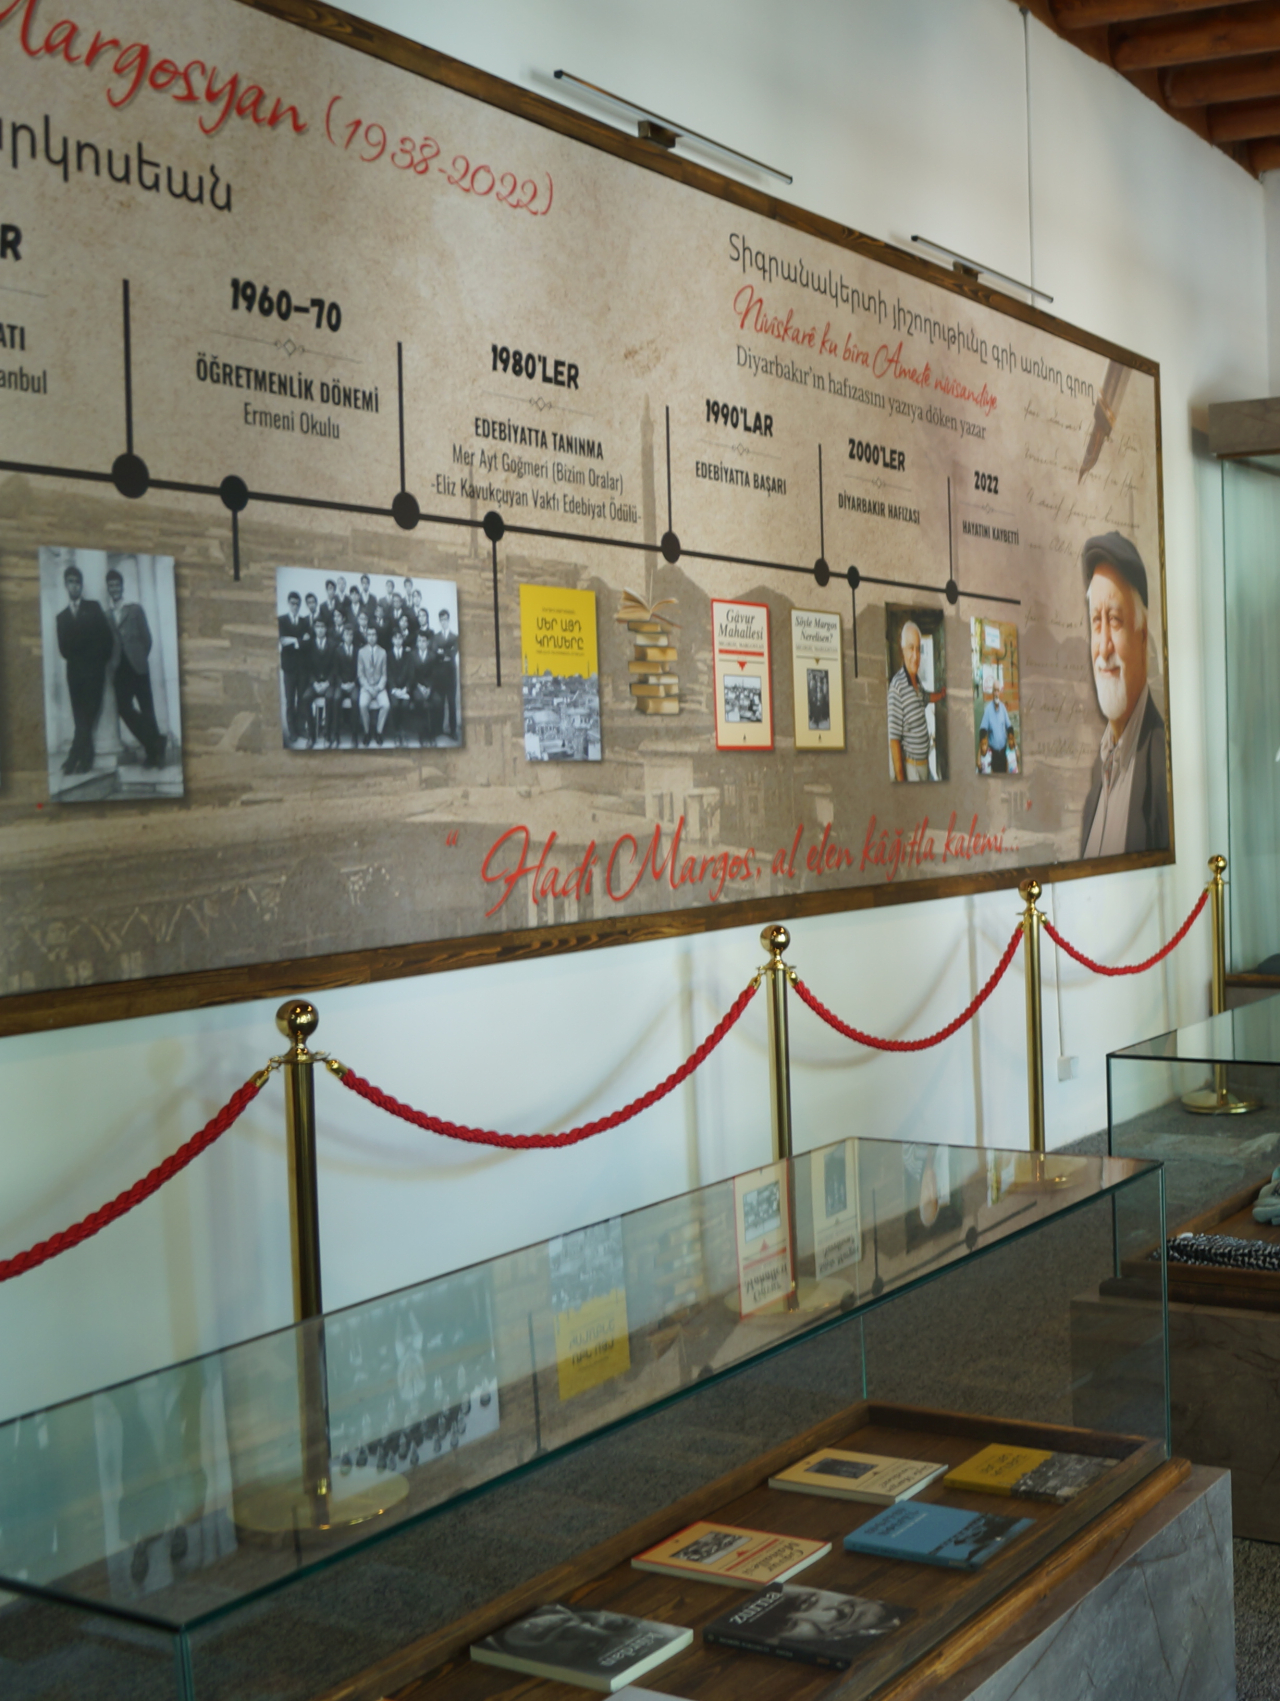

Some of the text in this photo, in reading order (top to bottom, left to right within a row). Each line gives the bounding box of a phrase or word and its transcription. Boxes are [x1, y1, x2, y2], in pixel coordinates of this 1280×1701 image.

[325, 95, 553, 216] (1938-2022)
[729, 233, 887, 324] Տիգրանակերտի
[992, 342, 1017, 375] գրի
[1066, 374, 1096, 406] գրող
[819, 321, 838, 358] ku
[842, 332, 870, 368] bîra
[196, 351, 380, 413] ÖĞRETMENLİK DÖNEMİ
[491, 343, 580, 390] 1980'LER
[243, 402, 340, 440] Ermeni Okulu
[705, 398, 774, 438] 1990'LAR
[828, 372, 886, 410] hafızasını
[887, 397, 923, 424] yazıya
[926, 404, 958, 431] döken
[959, 416, 987, 440] yazar
[474, 416, 604, 460] EDEBİYATTA TANINMA
[848, 438, 906, 472] 2000'LER
[452, 443, 623, 496] Mer Ayt Goğmeri (Bizim Oralar)
[695, 460, 787, 498] EDEBİYATTA BAŞARI
[973, 470, 1000, 495] 2022
[460, 478, 529, 508] Kavukçuyan
[532, 488, 560, 512] Vakfı
[563, 492, 607, 520] Edebiyat
[838, 492, 921, 526] DİYARBAKIR HAFIZASI
[718, 622, 765, 641] Mahallesi
[813, 617, 838, 632] Margos
[606, 815, 762, 902] Margos,
[771, 822, 804, 878] al
